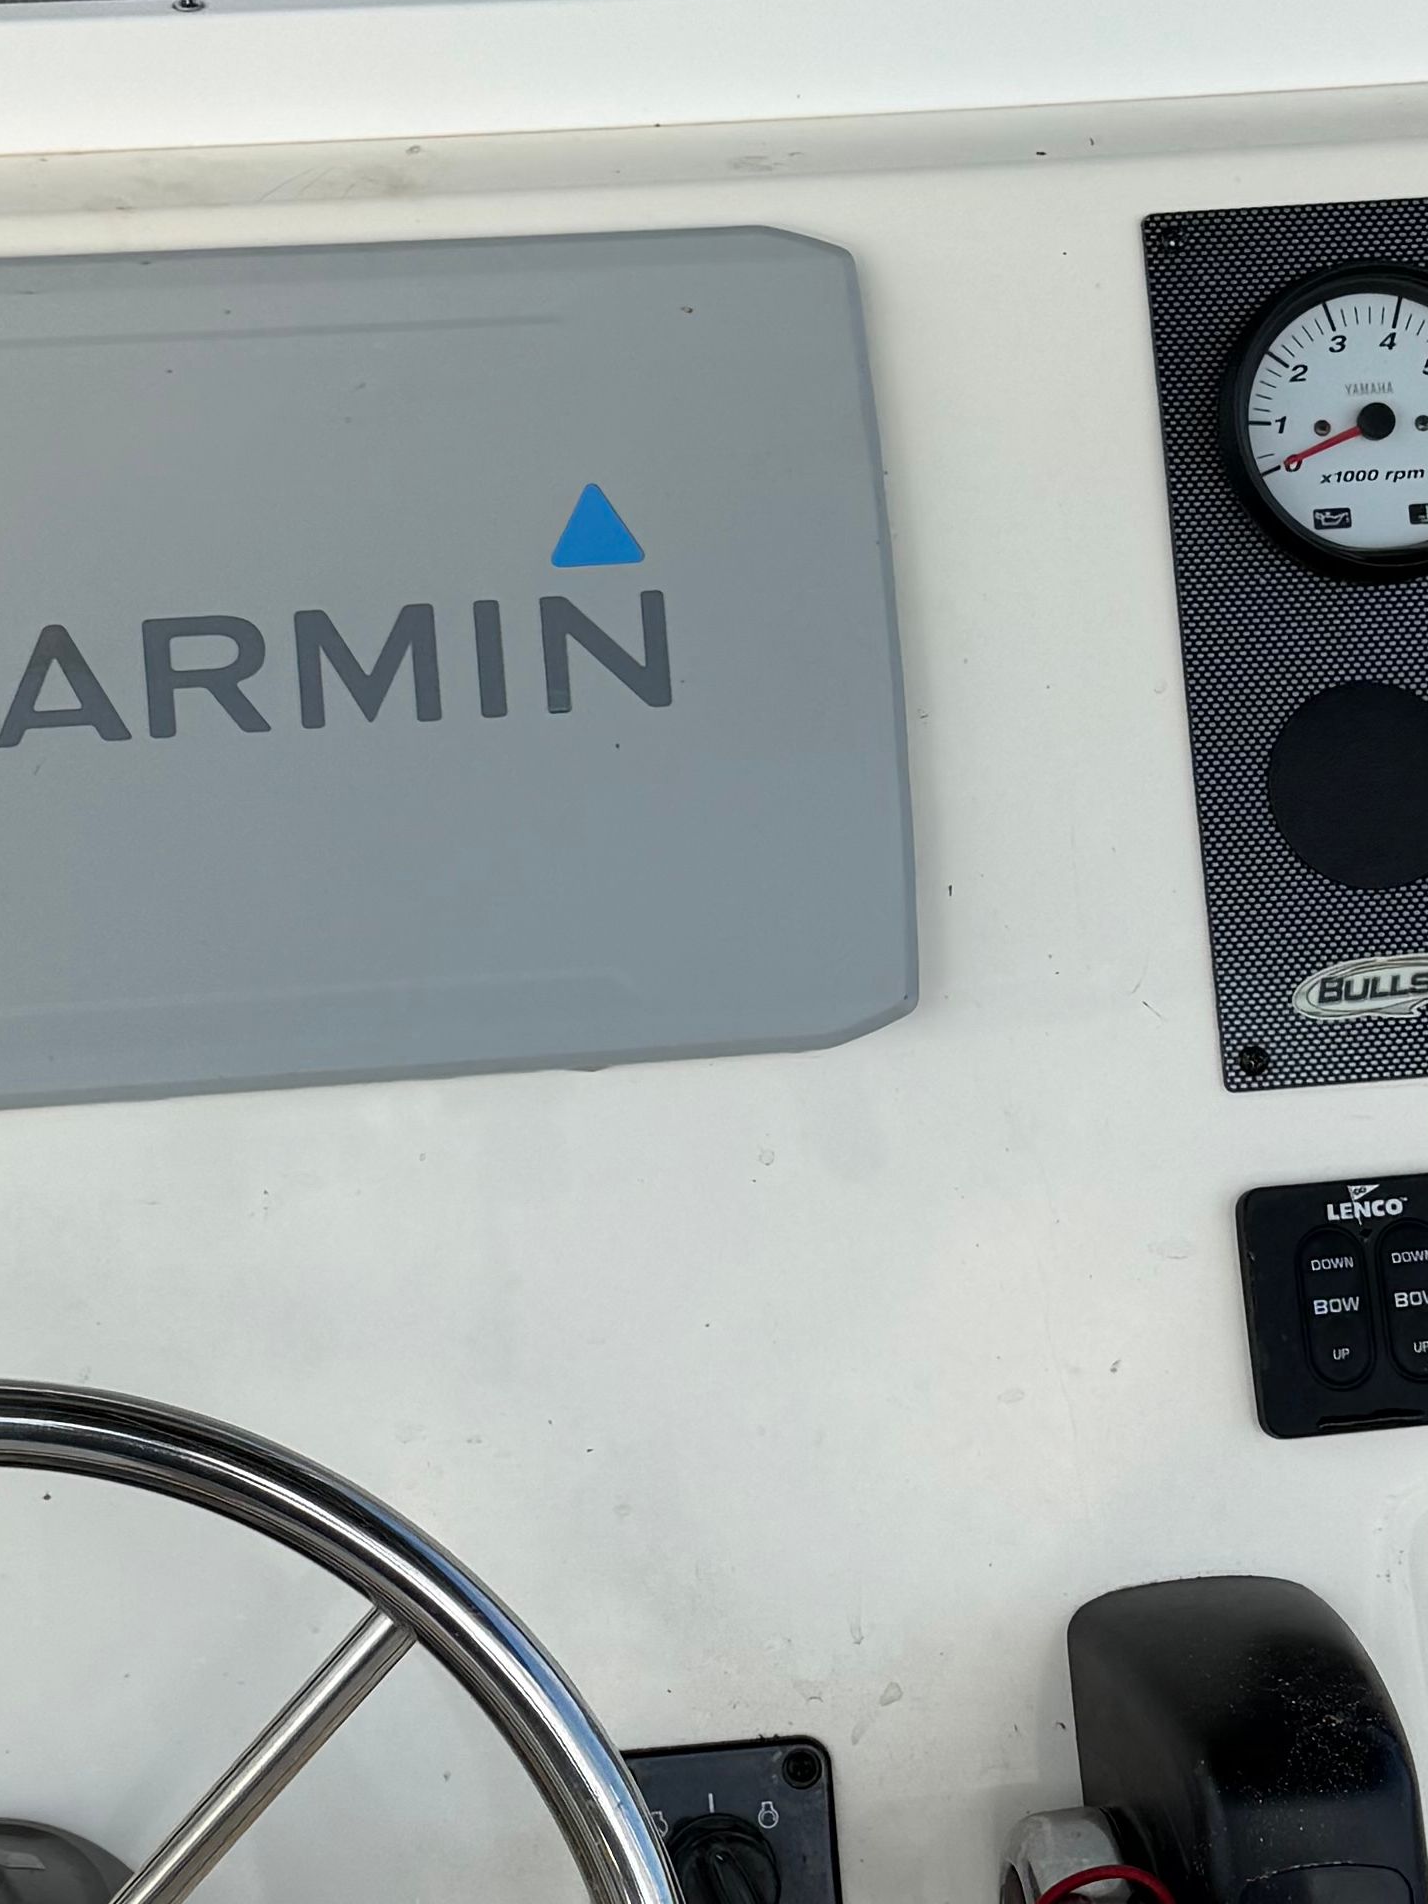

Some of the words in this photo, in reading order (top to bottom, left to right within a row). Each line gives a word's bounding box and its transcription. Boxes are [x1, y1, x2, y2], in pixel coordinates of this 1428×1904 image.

[1329, 335, 1347, 353] 3
[1379, 332, 1397, 350] 4
[1289, 364, 1308, 382] 2
[1345, 381, 1393, 396] YAMAHA
[1275, 416, 1287, 434] 1
[1320, 469, 1379, 484] x1000
[1385, 468, 1425, 483] rpm
[1327, 1198, 1403, 1221] LENCO
[1311, 1256, 1354, 1271] DOWN
[1314, 1296, 1360, 1315] BOW
[1333, 1348, 1350, 1361] UP
